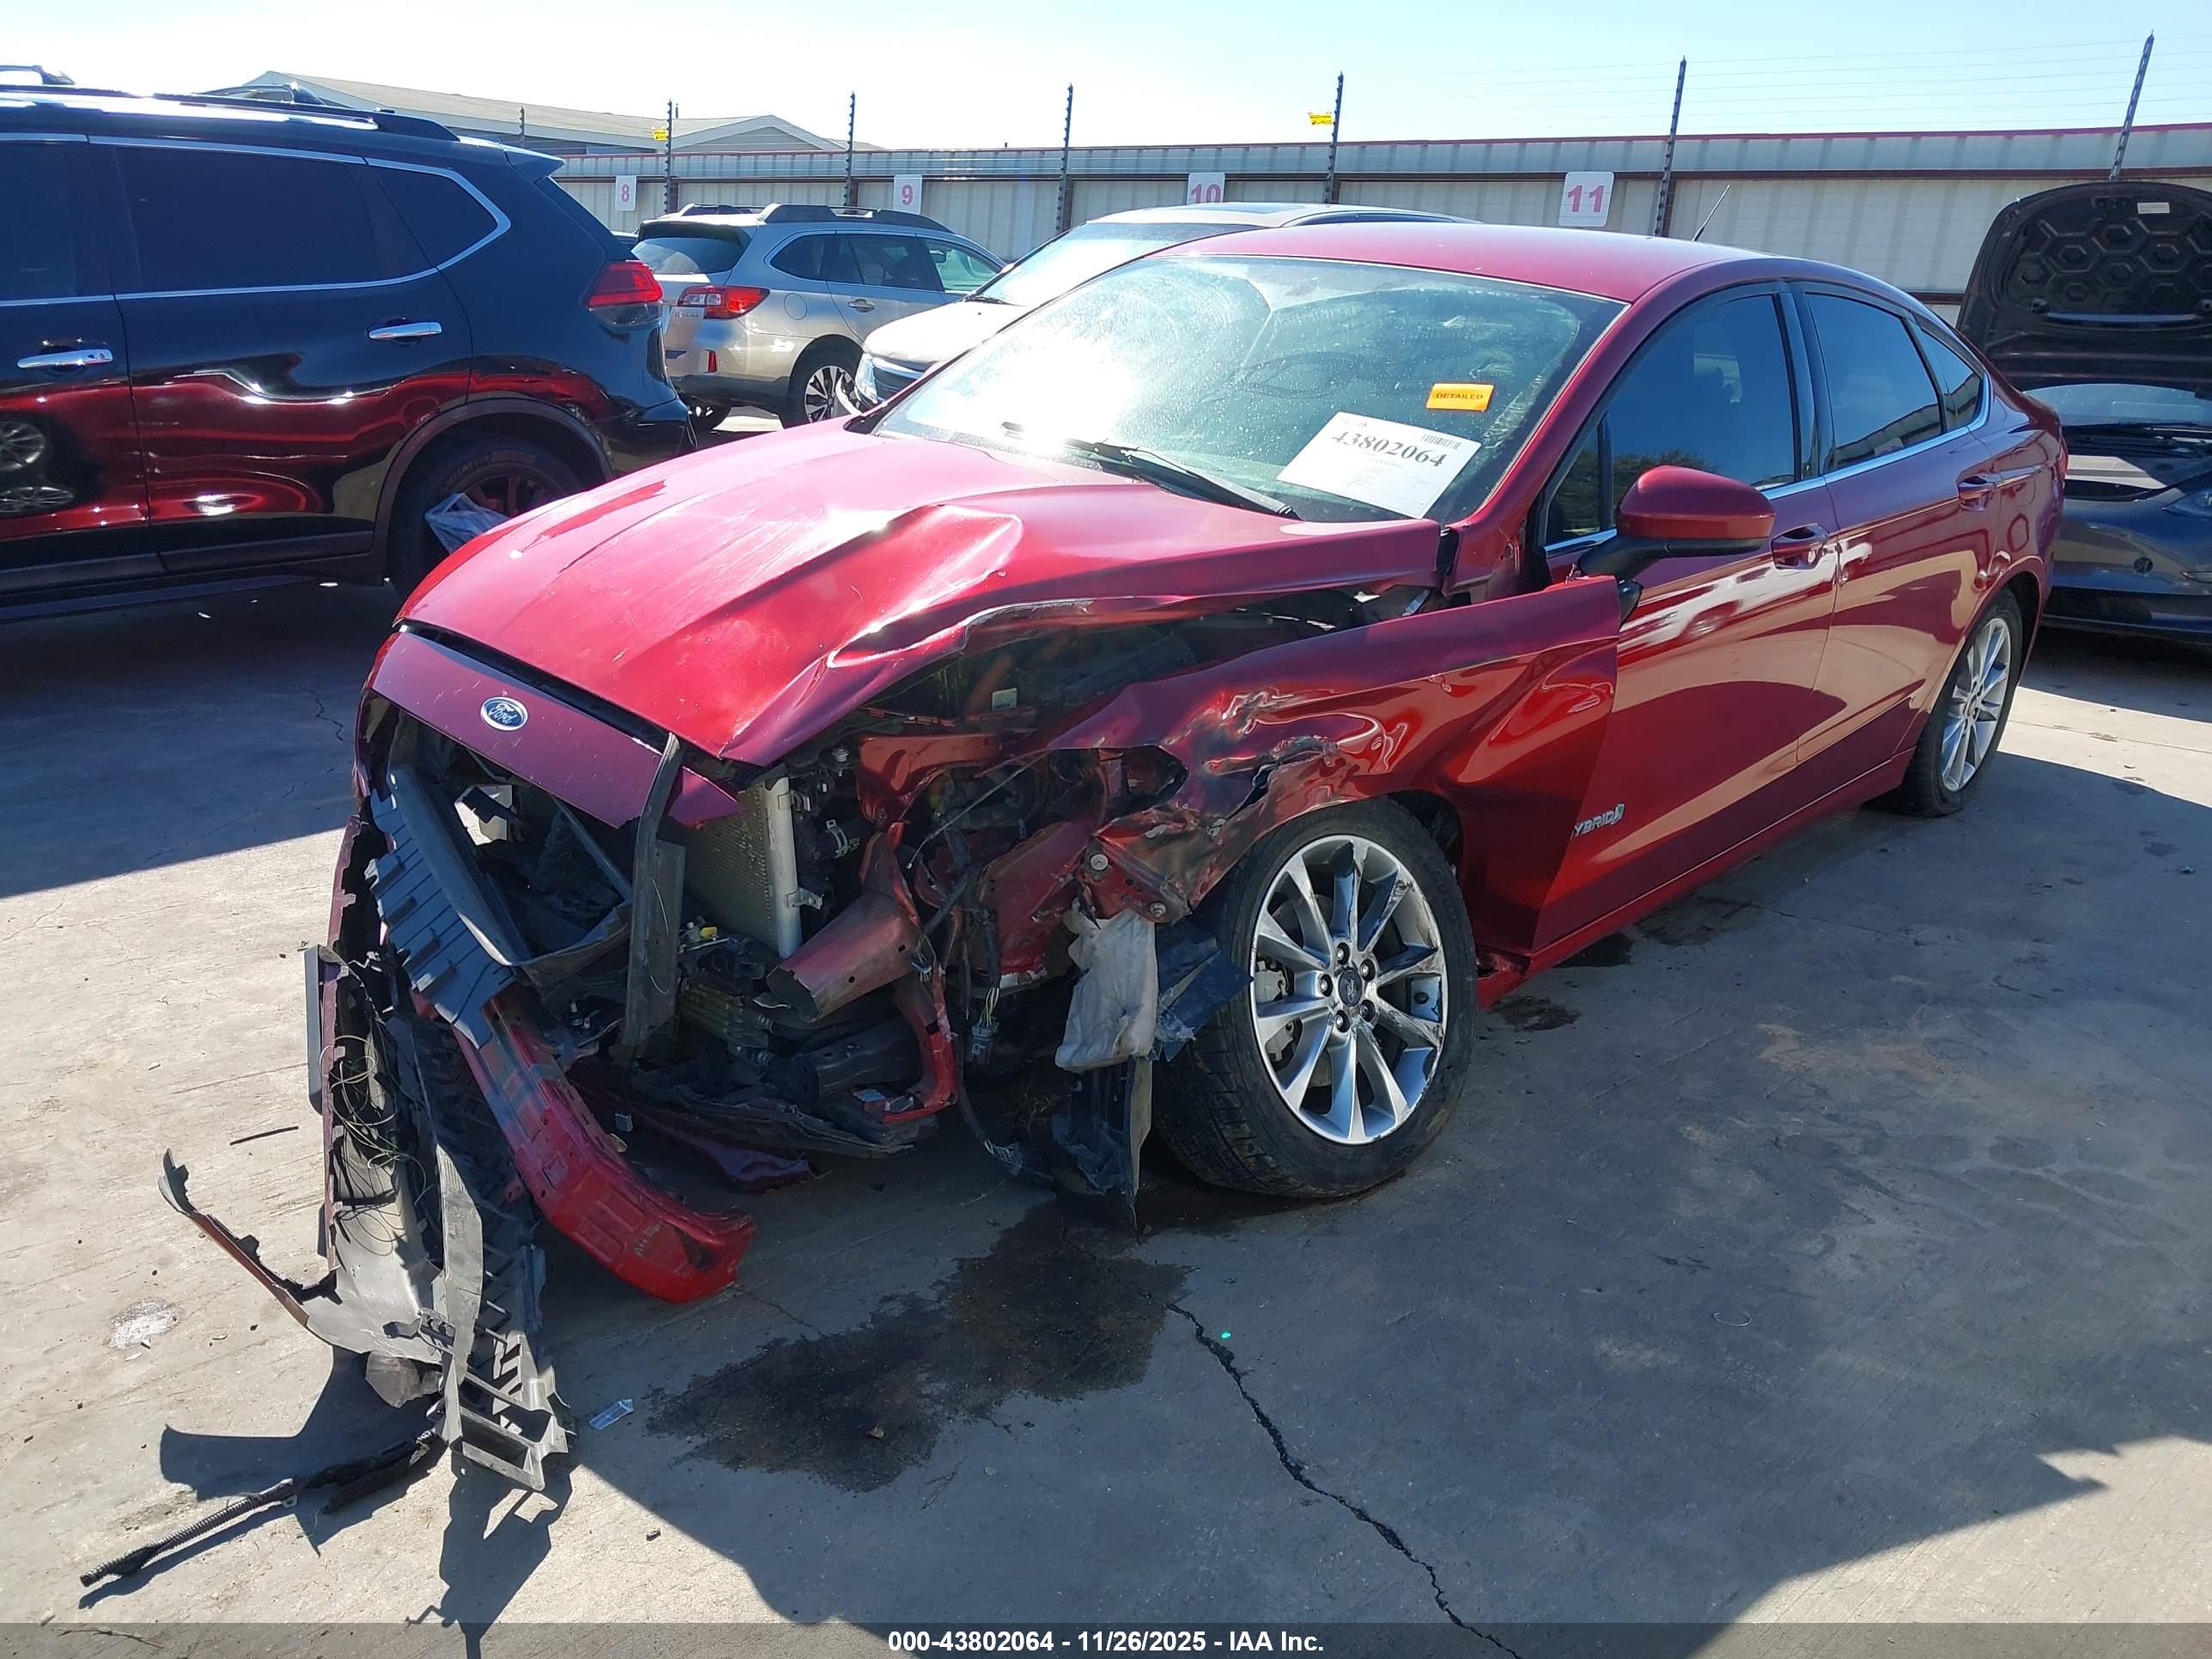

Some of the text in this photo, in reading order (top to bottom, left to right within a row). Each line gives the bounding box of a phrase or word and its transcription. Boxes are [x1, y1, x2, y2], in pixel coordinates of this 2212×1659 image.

[621, 184, 630, 203] 8
[902, 184, 914, 206] 9
[1191, 184, 1221, 204] 10
[1567, 185, 1605, 213] 11
[1332, 431, 1448, 467] 43802064
[488, 702, 518, 725] Ford
